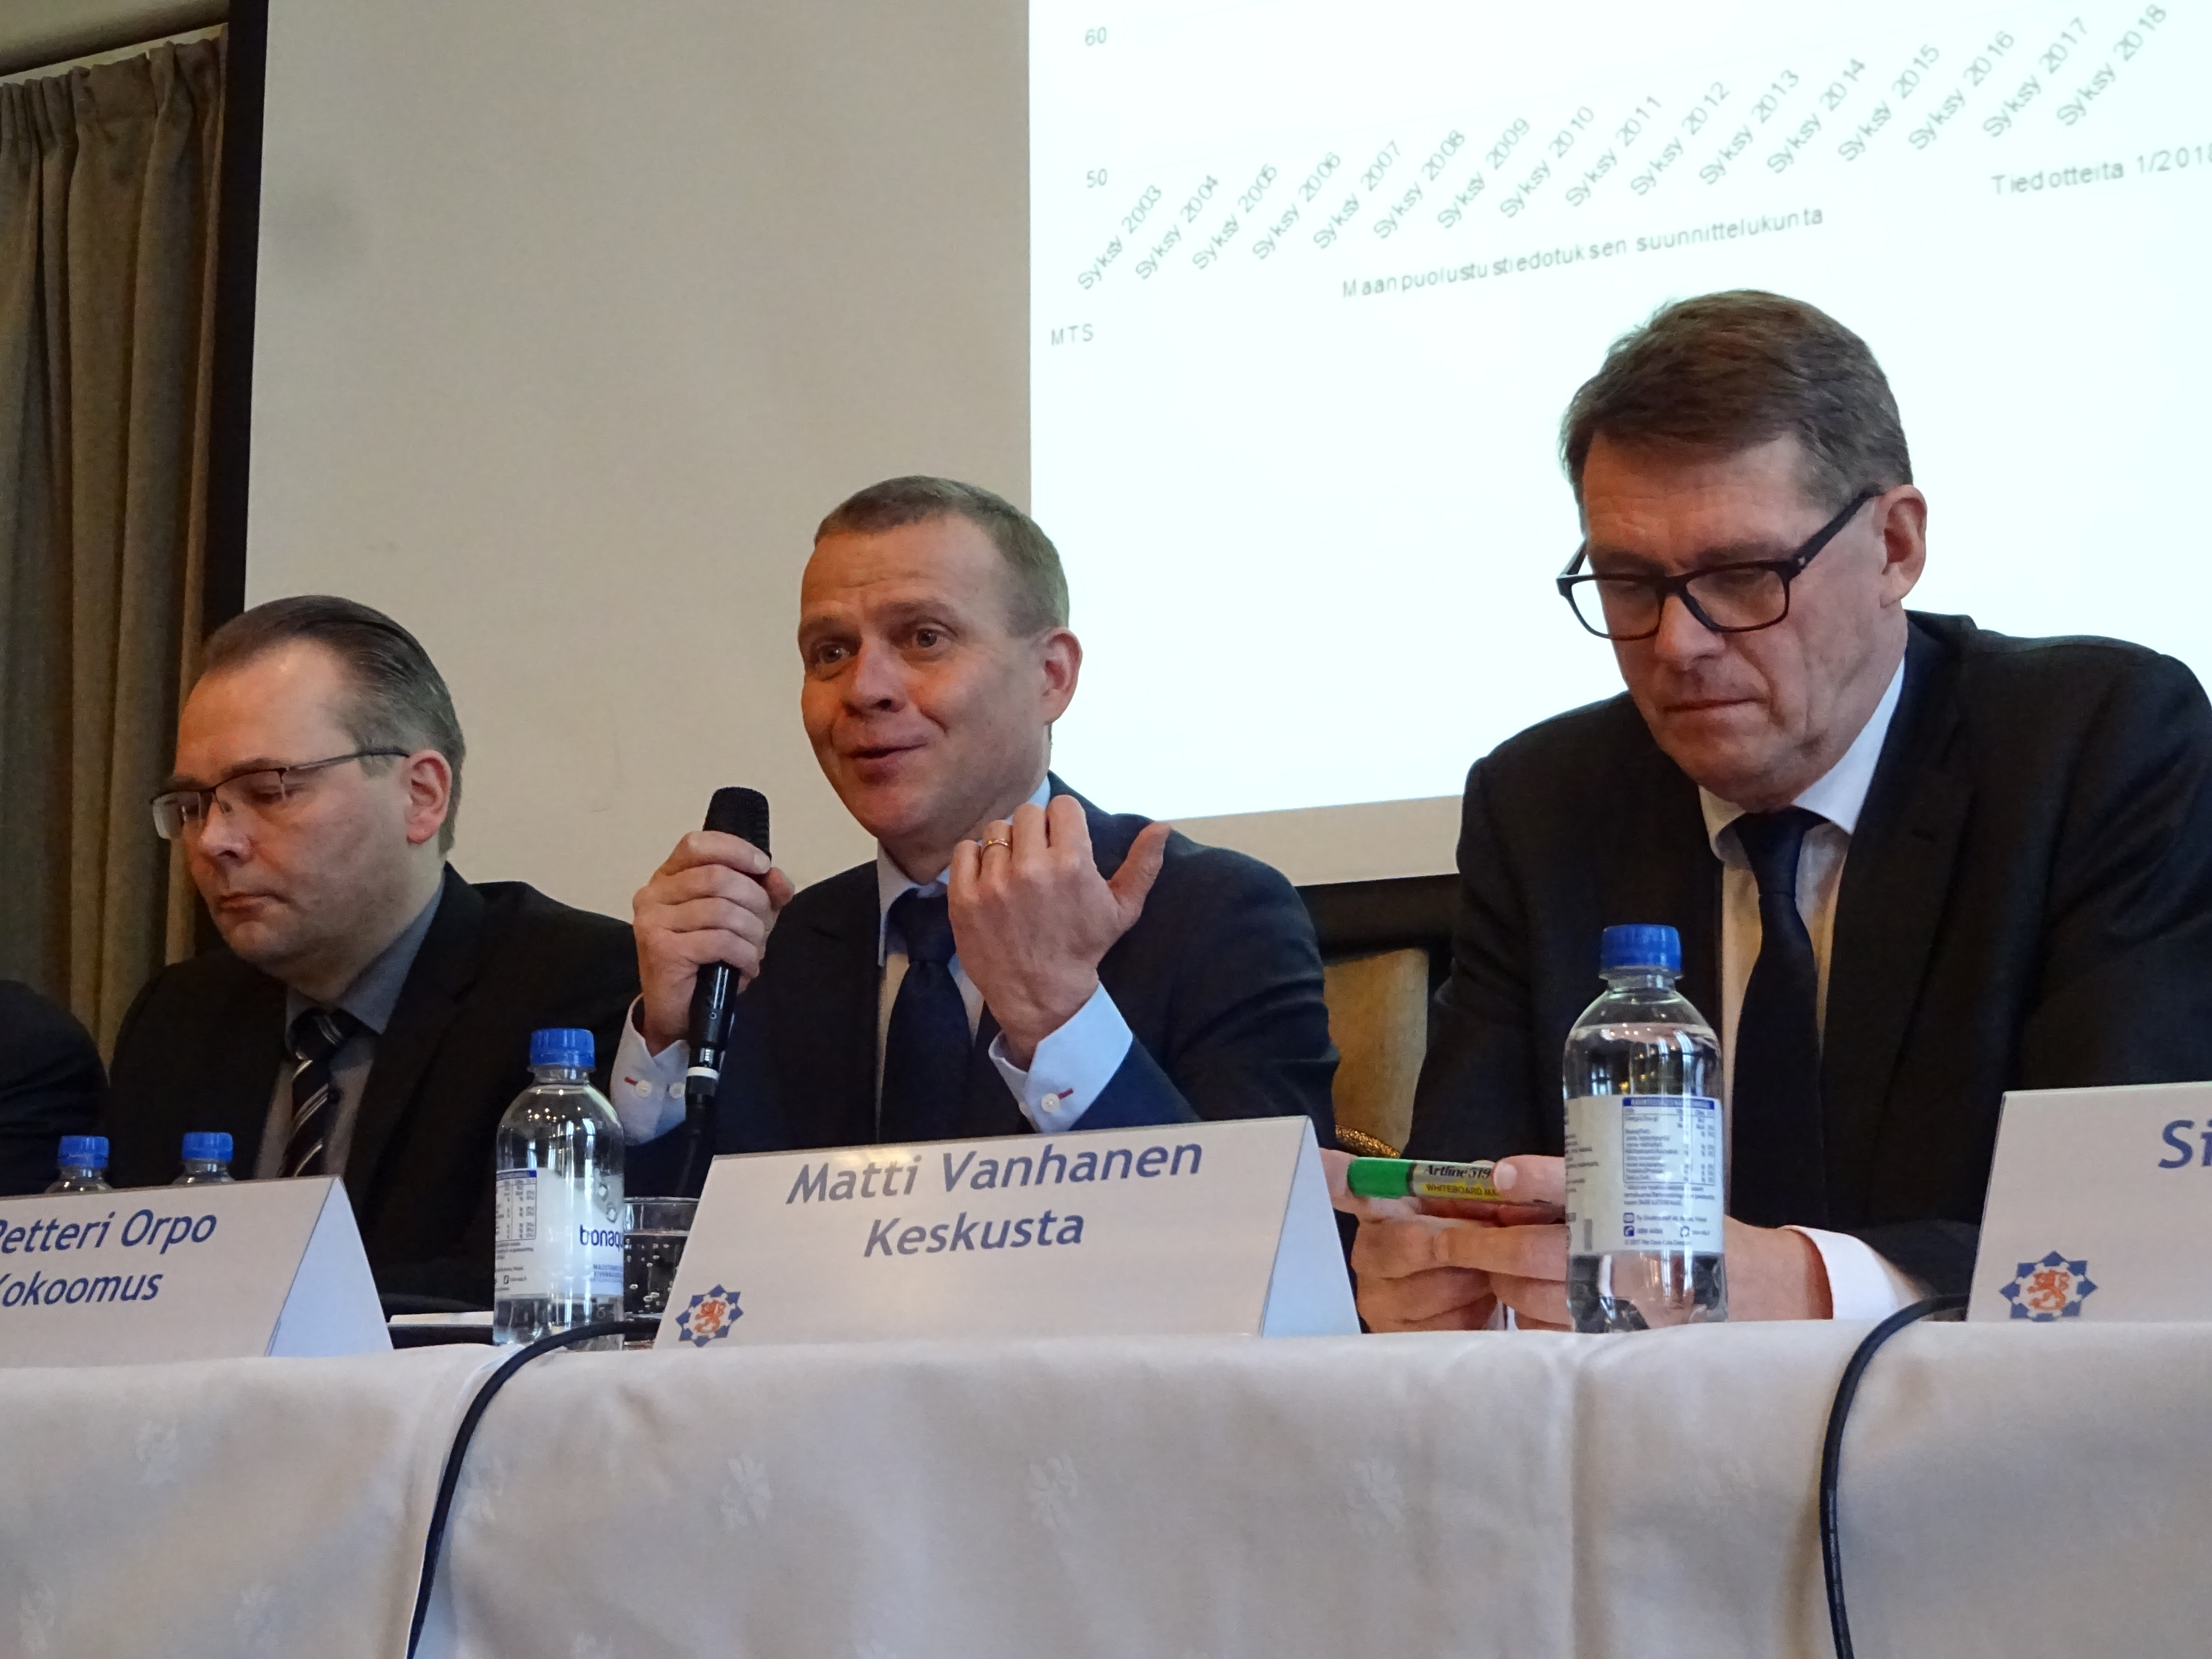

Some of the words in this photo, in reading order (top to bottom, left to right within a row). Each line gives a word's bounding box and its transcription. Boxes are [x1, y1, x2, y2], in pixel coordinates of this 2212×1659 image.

[1084, 26, 1108, 47] 60
[1982, 75, 2041, 138] Syksy
[2039, 17, 2087, 75] 2017
[2056, 63, 2116, 126] Syksy
[2113, 4, 2166, 61] 2018
[1630, 137, 1683, 196] Syksy
[1681, 81, 1730, 136] 2012
[1699, 124, 1753, 185] Syksy
[1751, 69, 1799, 124] 2013
[1767, 113, 1822, 174] Syksy
[1819, 58, 1865, 112] 2014
[1838, 100, 1892, 162] Syksy
[1892, 44, 1939, 99] 2015
[1908, 88, 1965, 150] Syksy
[1964, 31, 2014, 87] 2016
[1086, 168, 1108, 189] 50
[1313, 192, 1360, 249] Syksy
[1360, 140, 1401, 192] 2007
[1373, 181, 1423, 239] Syksy
[1421, 129, 1465, 182] 2008
[1437, 171, 1485, 229] Syksy
[1486, 117, 1530, 170] 2009
[1499, 159, 1551, 218] Syksy
[1549, 106, 1593, 159] 2010
[1565, 148, 1617, 207] Syksy
[1616, 96, 1661, 147] 2011
[1990, 161, 2125, 195] Tiedotteita
[1078, 235, 1122, 290] Syksy
[1121, 185, 1162, 234] 2003
[1135, 224, 1181, 280] Syksy
[1180, 175, 1218, 224] 2004
[1192, 213, 1239, 270] Syksy
[1237, 164, 1277, 214] 2005
[1252, 203, 1299, 260] Syksy
[1298, 152, 1340, 202] 2006
[1636, 206, 1823, 253] suunnittelukunta
[1050, 323, 1094, 347] MTS
[785, 1154, 922, 1204] Matti
[941, 1142, 1203, 1193] Vanhanen
[1425, 1165, 1467, 1177] Artline
[1426, 1183, 1482, 1195] WHITEBOARD
[121, 1209, 217, 1255] Orpo
[862, 1209, 1085, 1257] Keskusta
[0, 1271, 164, 1307] okoomus
